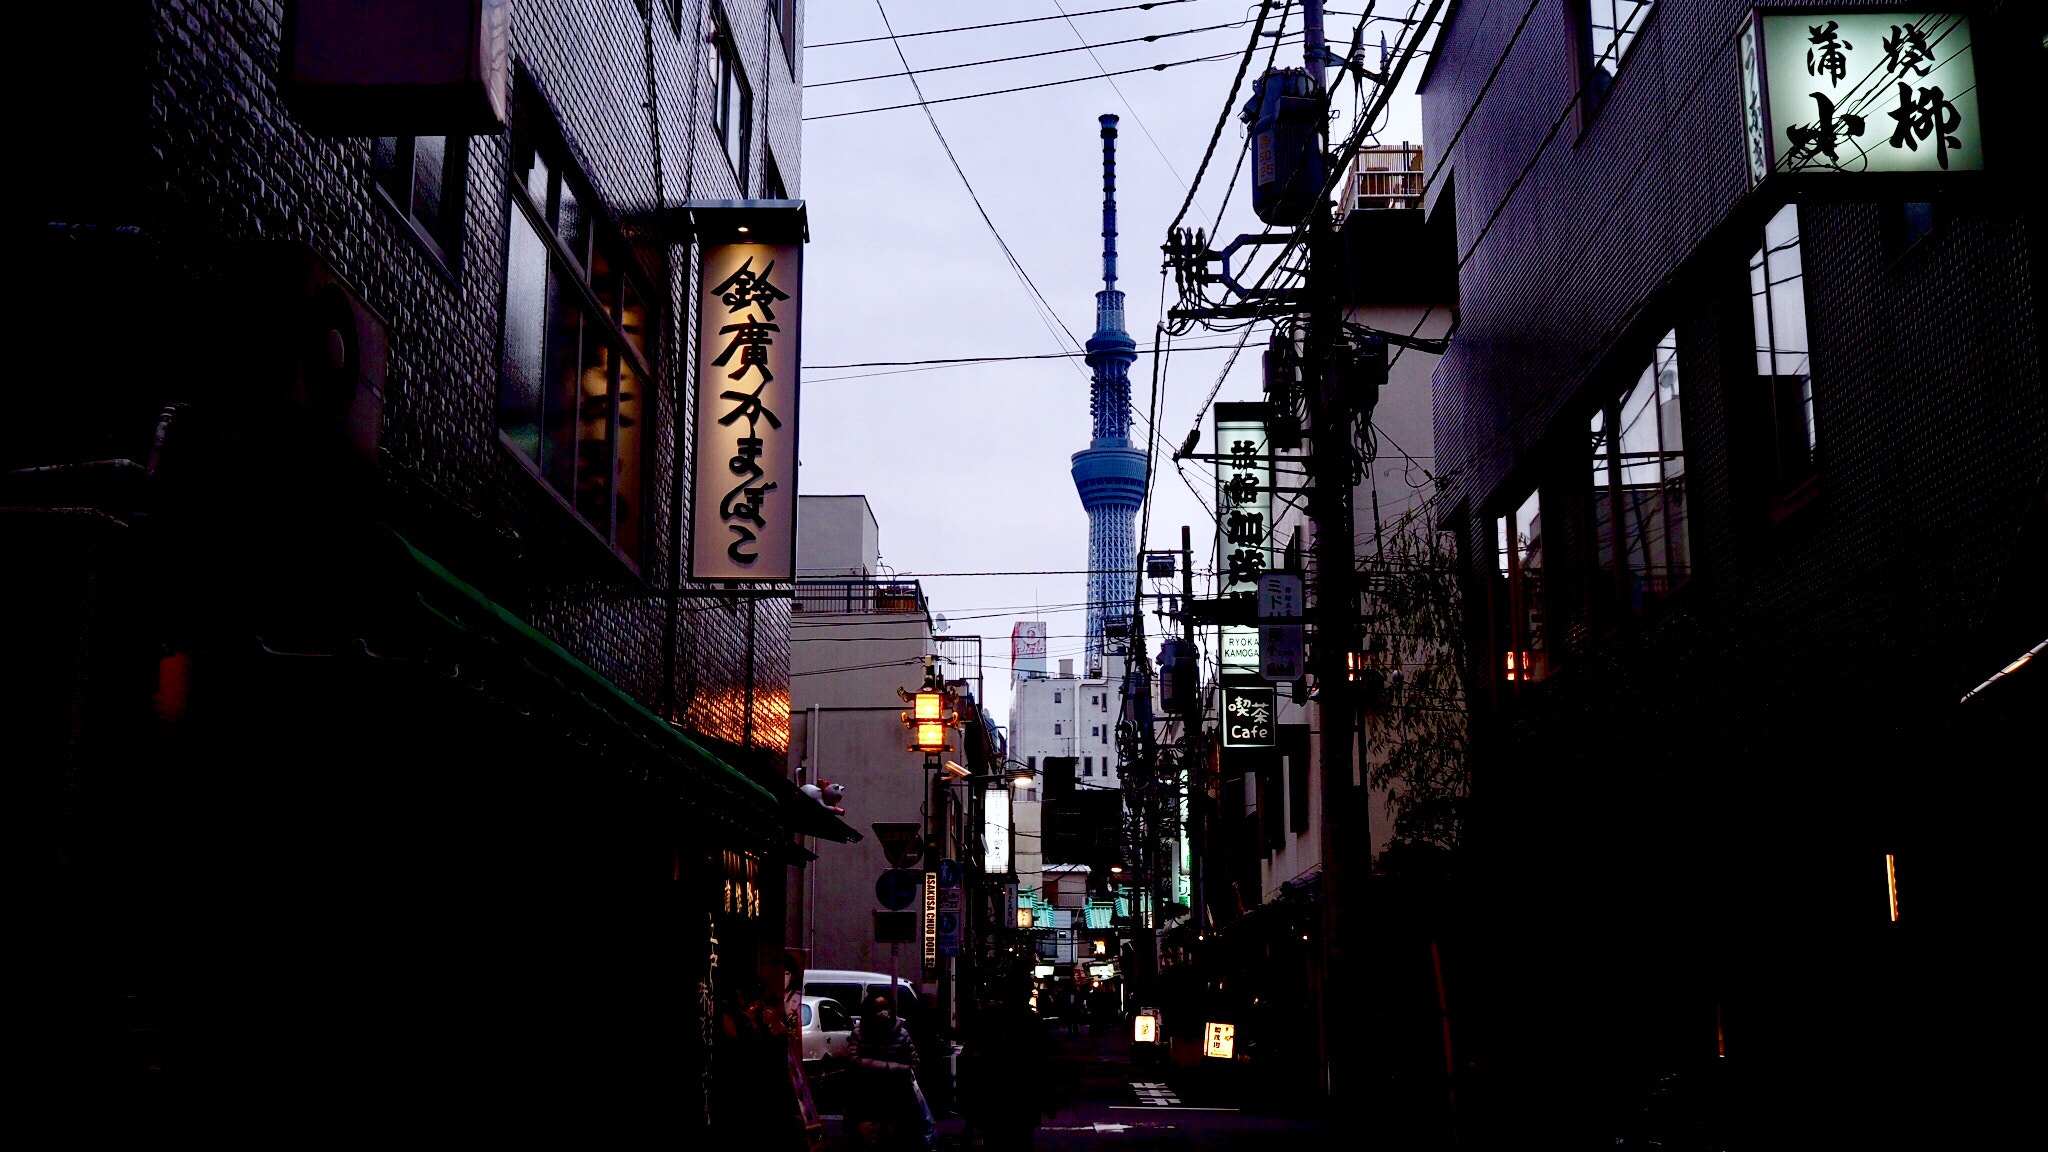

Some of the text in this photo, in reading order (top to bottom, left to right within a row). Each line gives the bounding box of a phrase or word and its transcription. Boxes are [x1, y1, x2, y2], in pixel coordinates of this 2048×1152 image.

[1786, 81, 1963, 171] 小柳
[711, 256, 790, 564] 鈴廣かまぼこ
[1228, 696, 1270, 724] 喫茶
[1231, 725, 1268, 739] Cafe
[926, 874, 936, 911] ASAKUSA
[926, 912, 936, 935] CHUO
[925, 936, 935, 956] DORI
